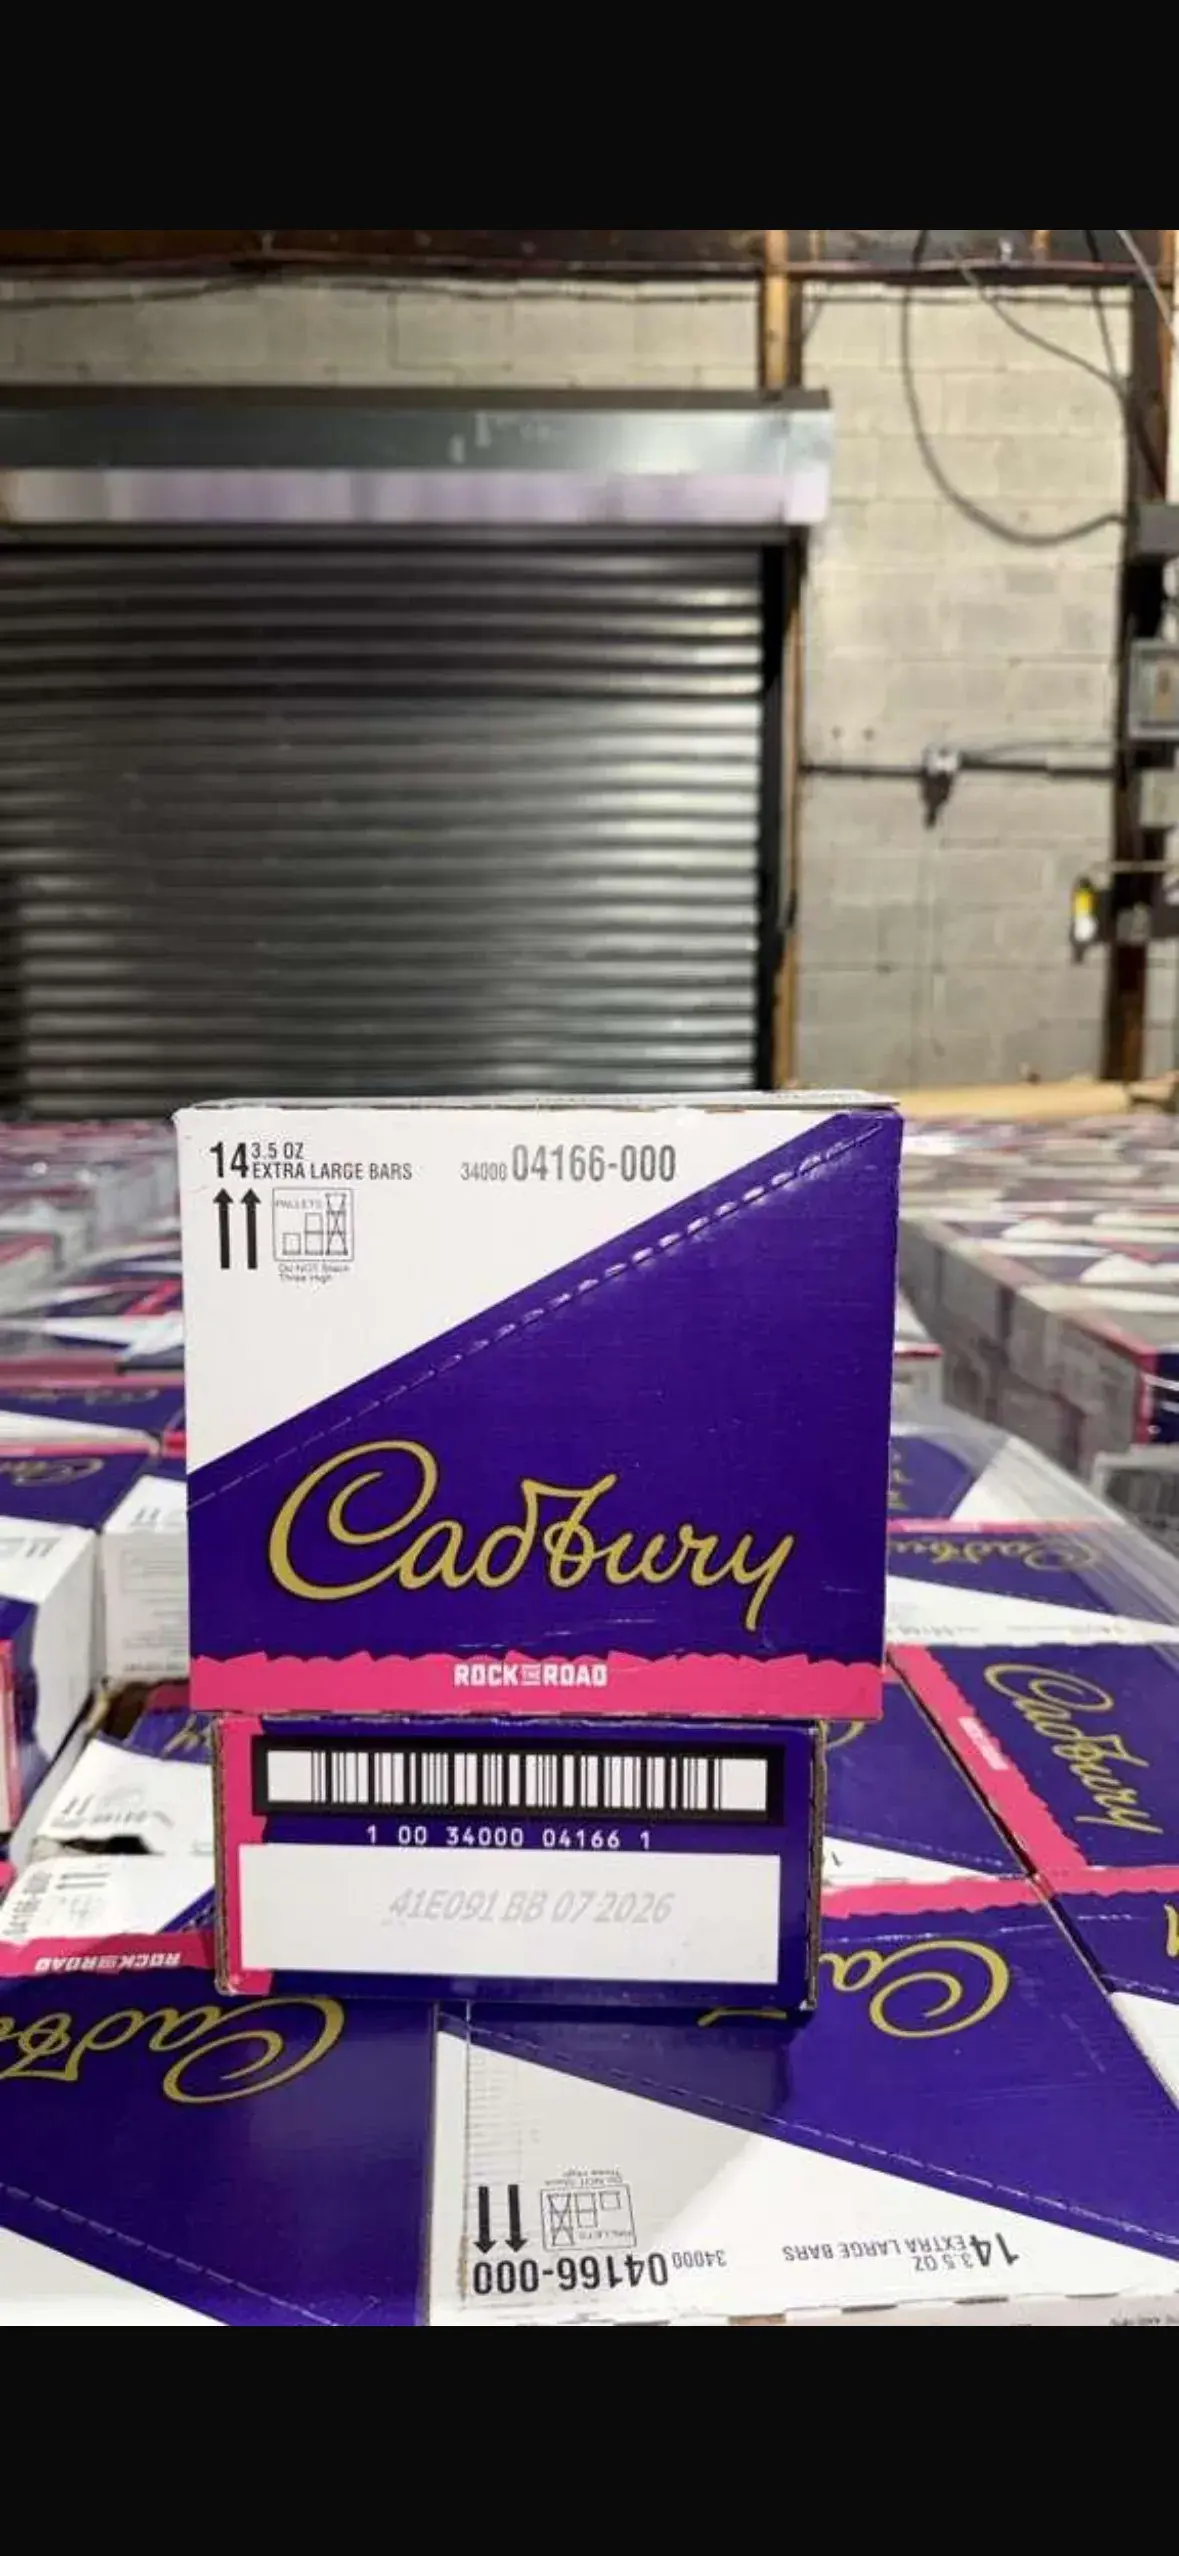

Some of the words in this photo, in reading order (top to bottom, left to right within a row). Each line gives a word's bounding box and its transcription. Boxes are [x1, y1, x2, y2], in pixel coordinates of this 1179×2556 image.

[210, 1141, 249, 1179] 14
[251, 1142, 277, 1160] 3.5
[283, 1142, 304, 1160] OZ
[253, 1161, 305, 1180] EXTRA
[310, 1162, 363, 1181] LARGE
[369, 1163, 413, 1181] BARS
[460, 1161, 507, 1182] 34000
[512, 1144, 676, 1183] 04166-000
[268, 1438, 795, 1632] Cadbury
[453, 1663, 519, 1687] ROCK
[543, 1663, 608, 1687] ROAD
[983, 1664, 1163, 1834] Cadbury
[366, 1825, 377, 1845] 1
[398, 1825, 427, 1845] 00
[446, 1826, 524, 1847] 34000
[542, 1828, 621, 1849] 04166
[640, 1830, 651, 1850] 1
[552, 1890, 598, 1923] 07
[593, 1891, 676, 1924] 2026
[782, 2243, 834, 2262] BARS
[837, 2239, 900, 2259] LARGE
[904, 2234, 968, 2253] EXTRA
[969, 2232, 1019, 2268] 14
[672, 2249, 727, 2269] 34000
[911, 2254, 938, 2271] OZ
[942, 2252, 973, 2270] 3.5
[473, 2252, 669, 2295] 04166-000
